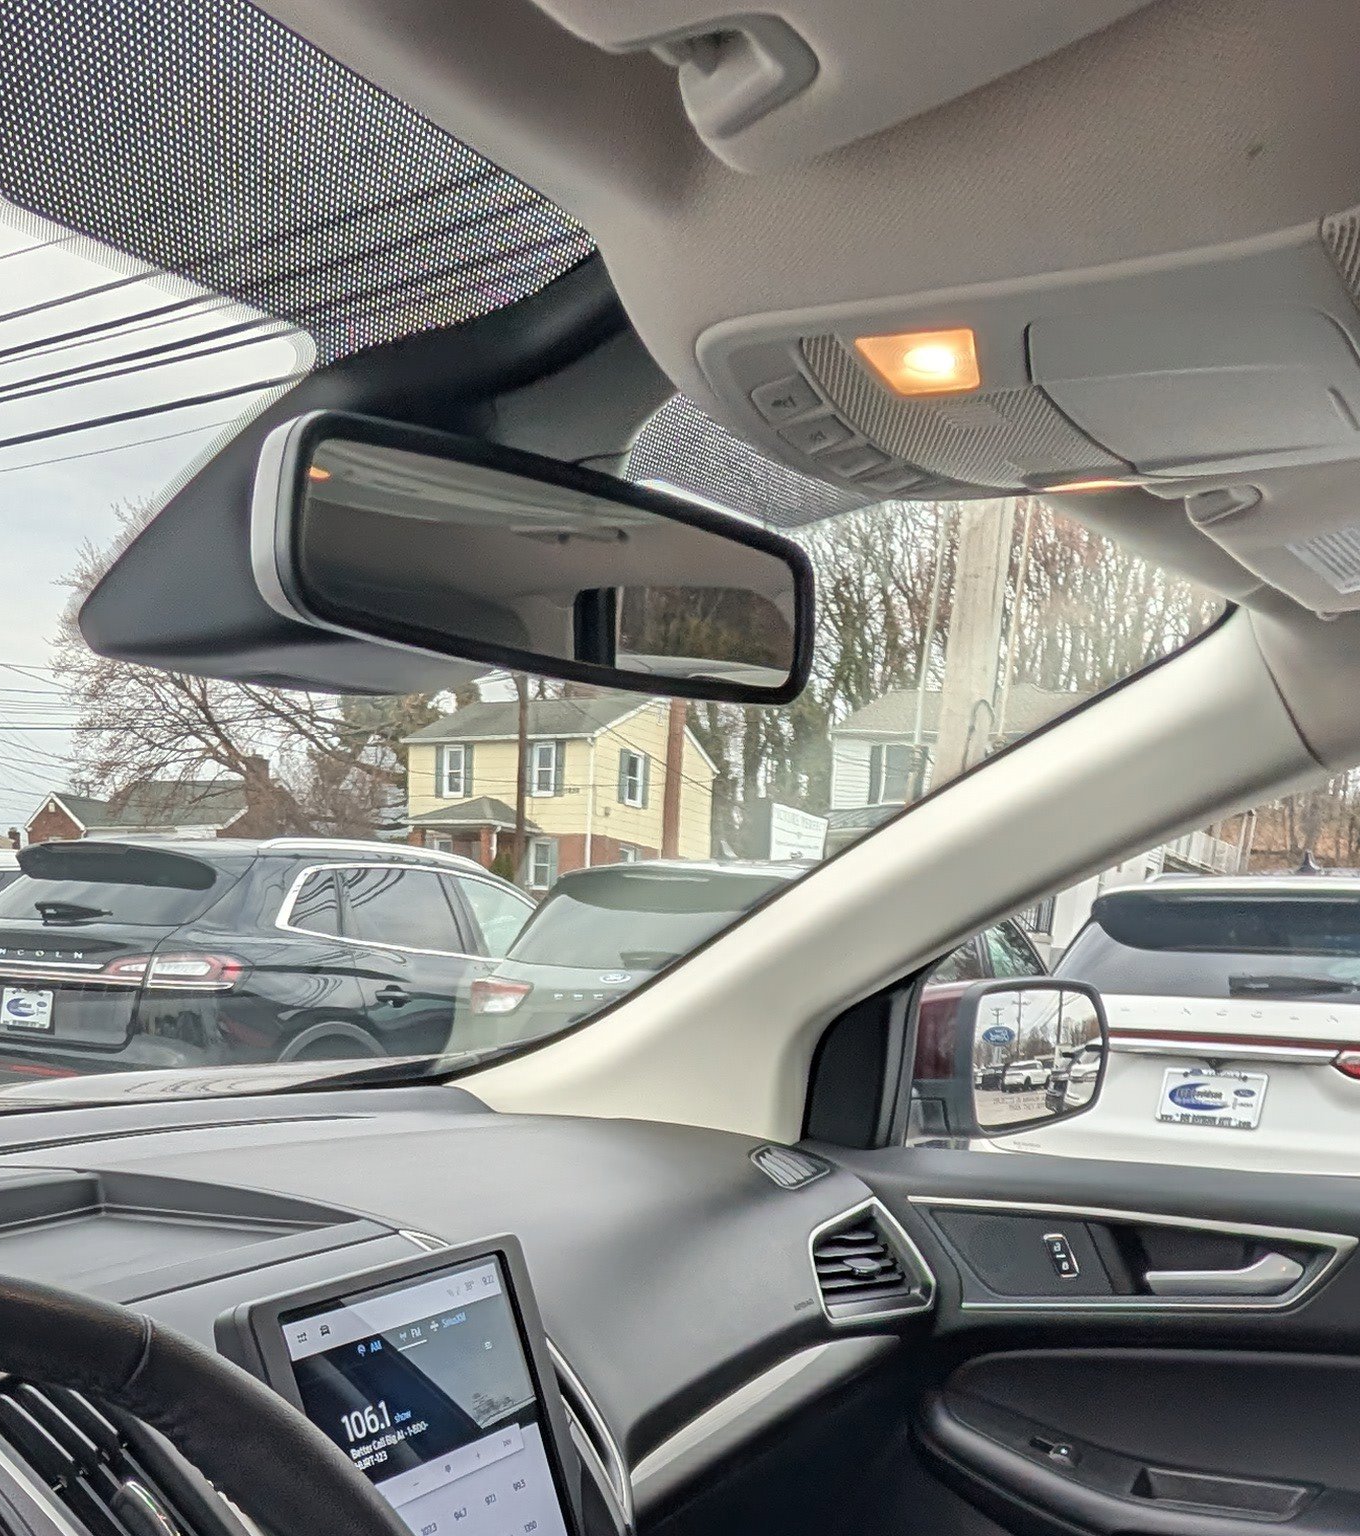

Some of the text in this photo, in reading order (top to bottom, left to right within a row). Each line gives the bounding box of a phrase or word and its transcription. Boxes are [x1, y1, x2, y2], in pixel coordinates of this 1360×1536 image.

[370, 1340, 383, 1353] AM
[411, 1328, 422, 1338] FM
[340, 1400, 412, 1443] 106.1 show
[350, 1442, 373, 1460] Better
